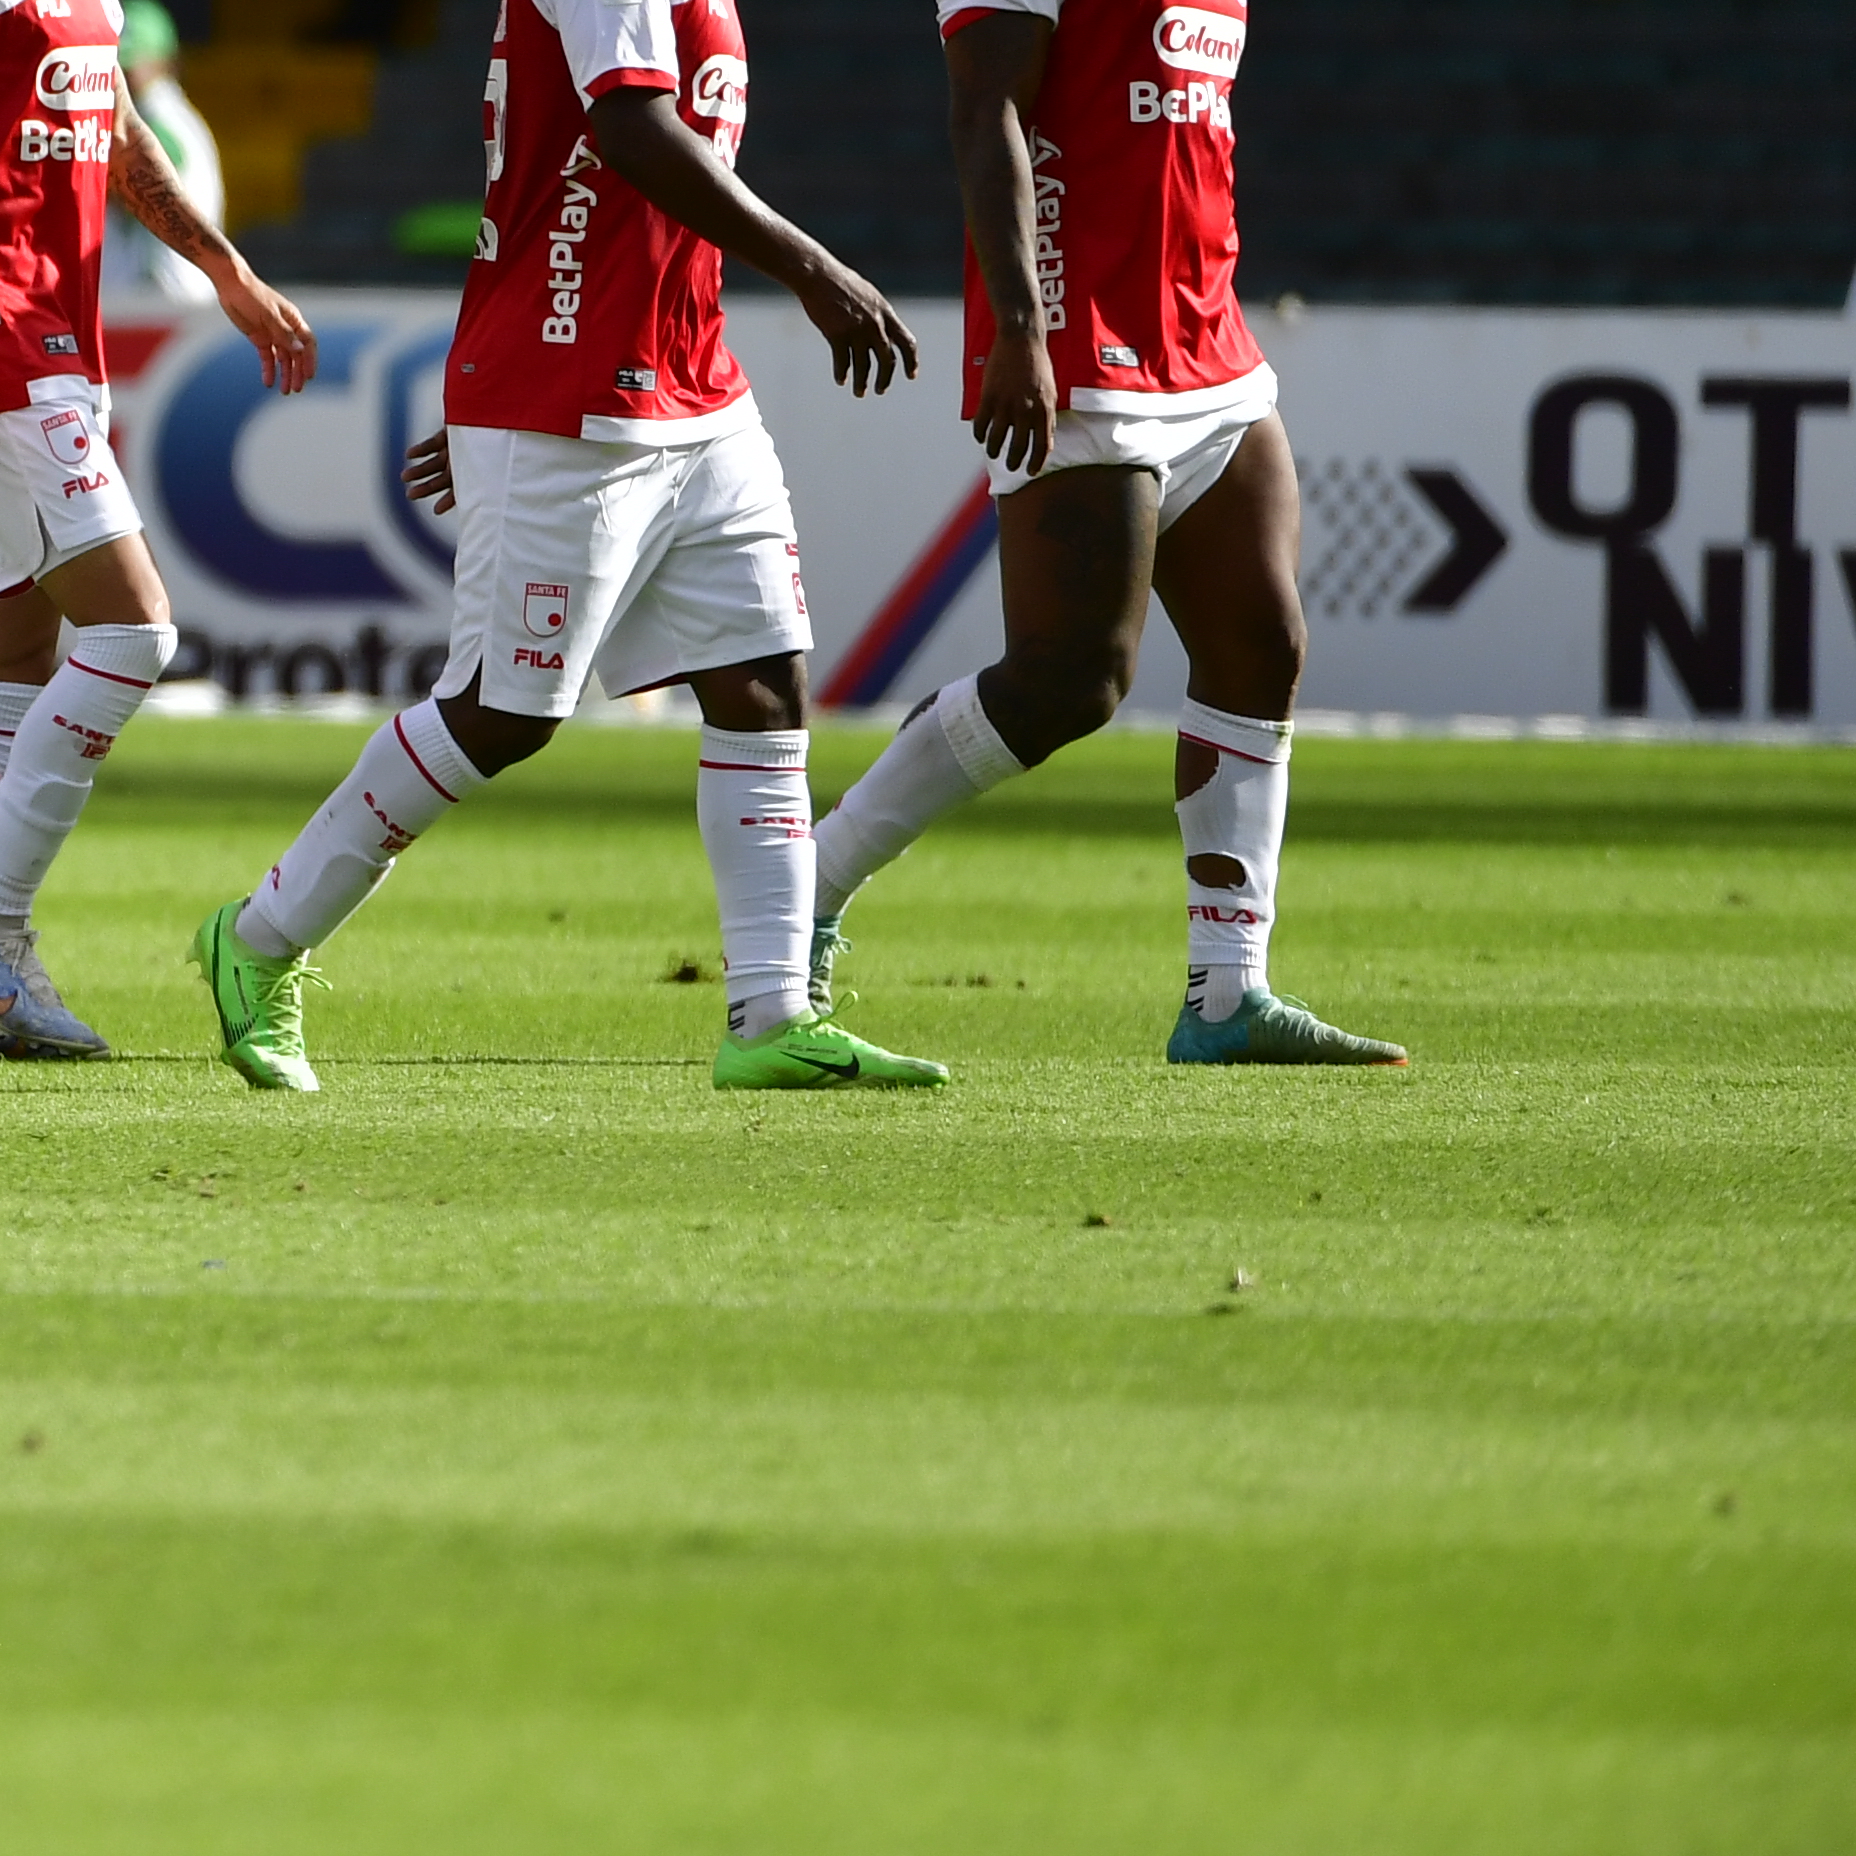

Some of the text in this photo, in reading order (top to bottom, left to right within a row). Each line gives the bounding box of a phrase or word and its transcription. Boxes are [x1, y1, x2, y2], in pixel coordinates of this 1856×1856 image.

[40, 60, 117, 95] Colant
[542, 179, 597, 345] BetPlay
[61, 471, 110, 499] FILA
[528, 585, 567, 597] SANTA FE
[1605, 544, 1856, 717] NI
[513, 647, 565, 671] FILA
[1187, 905, 1257, 924] FILA
